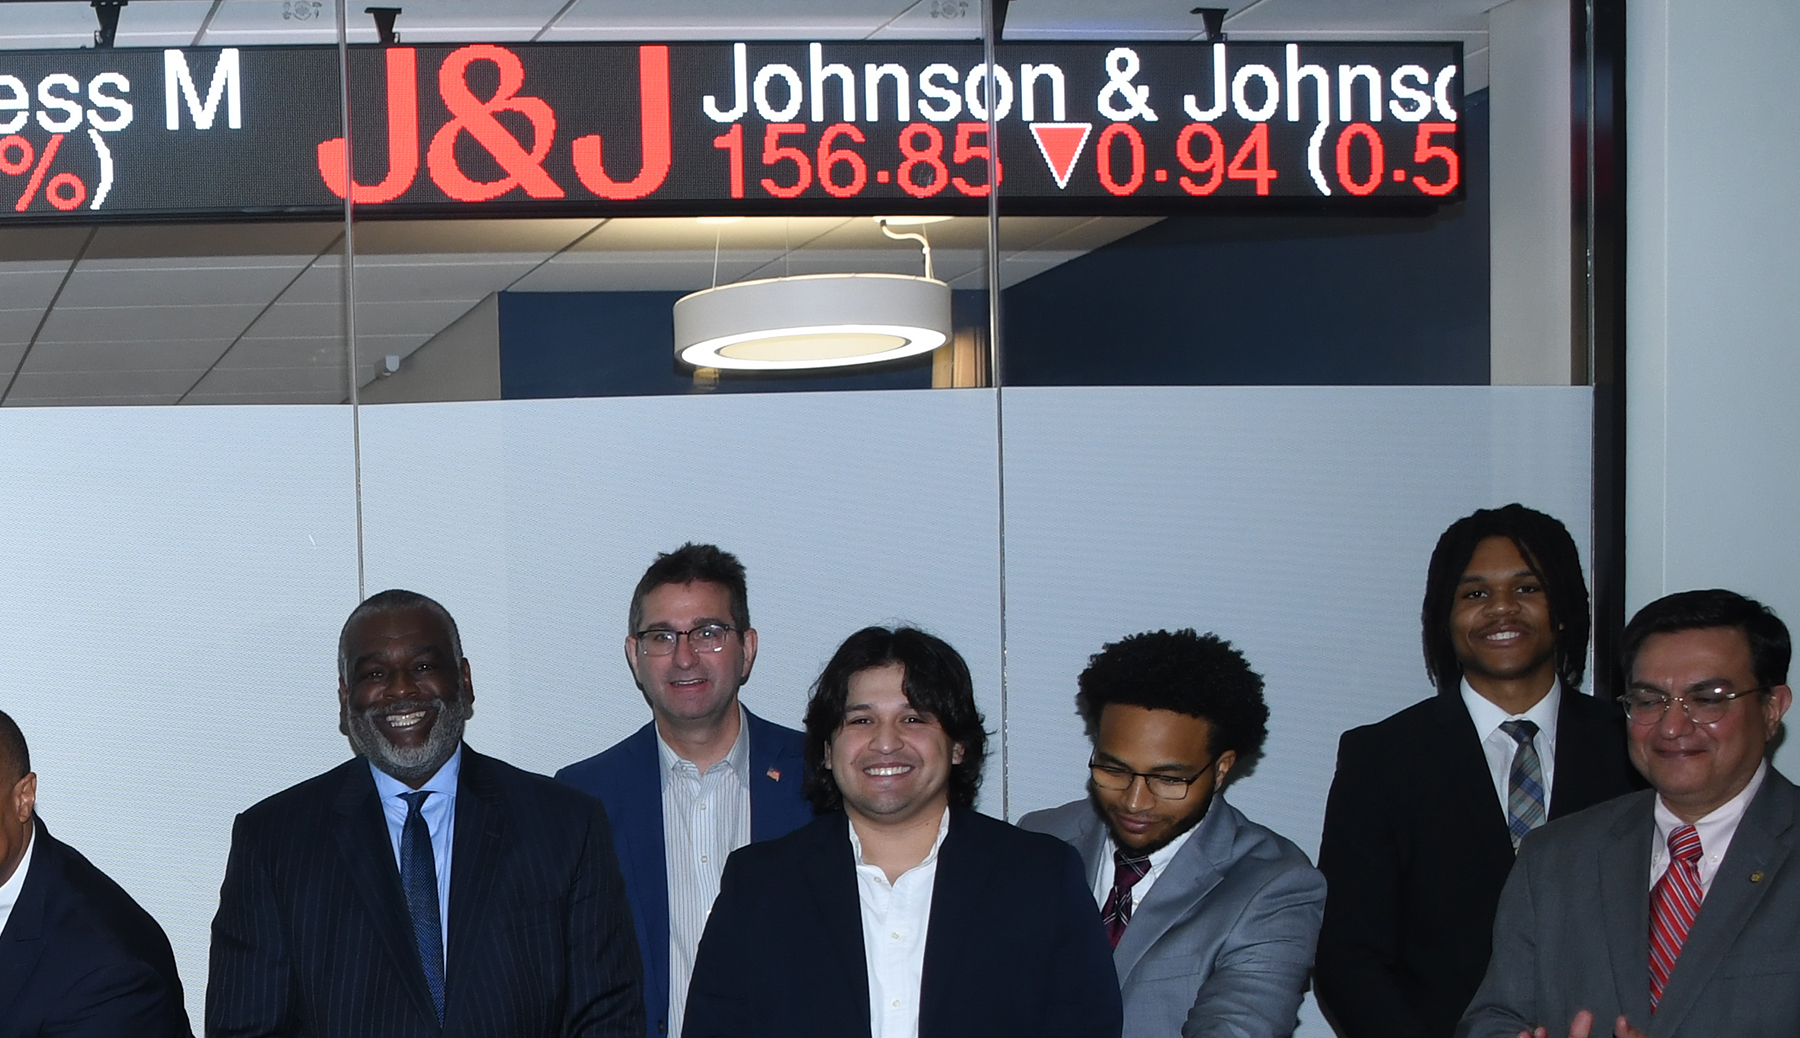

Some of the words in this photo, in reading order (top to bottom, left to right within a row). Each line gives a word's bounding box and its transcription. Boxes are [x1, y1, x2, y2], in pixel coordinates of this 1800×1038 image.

[164, 48, 242, 130] M
[703, 42, 1066, 123] Johnson
[1097, 47, 1159, 121] &
[317, 44, 671, 203] J&J
[713, 122, 1003, 199] 156.85
[1097, 122, 1277, 196] 0.94
